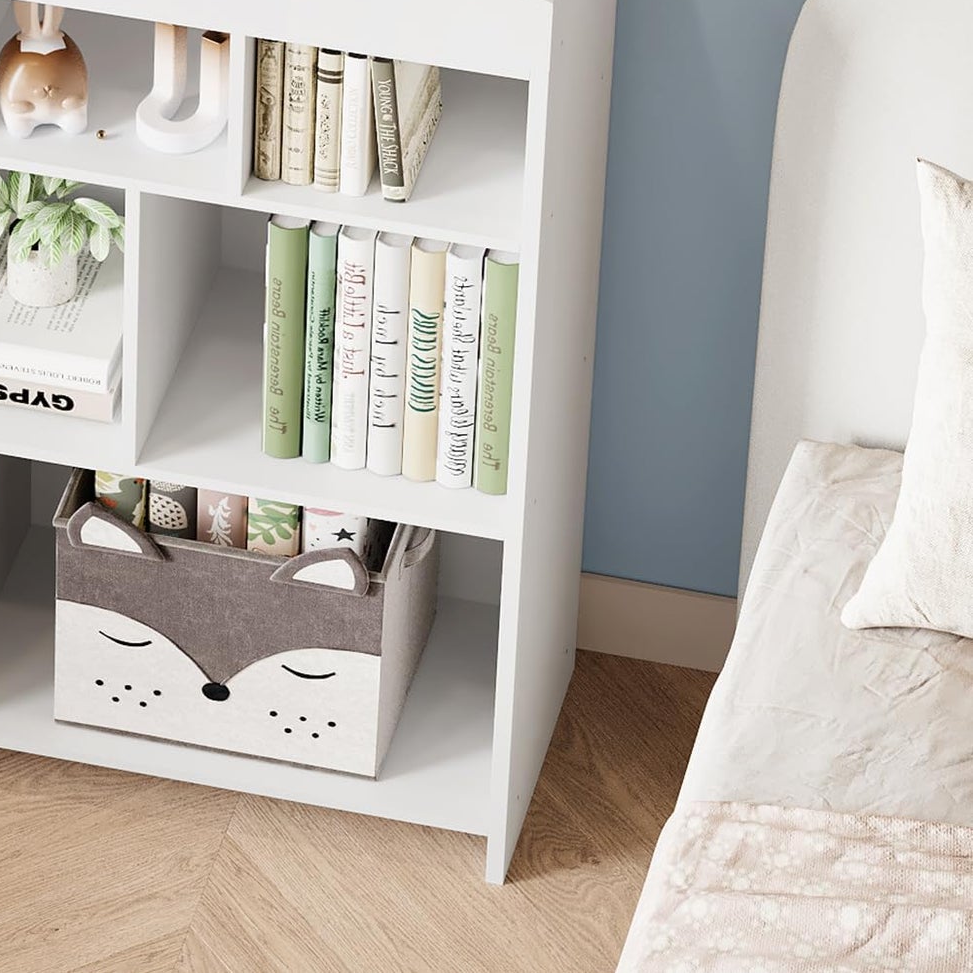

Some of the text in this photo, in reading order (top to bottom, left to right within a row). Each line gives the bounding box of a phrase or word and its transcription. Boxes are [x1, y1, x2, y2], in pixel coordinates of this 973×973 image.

[377, 79, 399, 176] YOUNG THE SHACK
[67, 374, 101, 386] ROBERT
